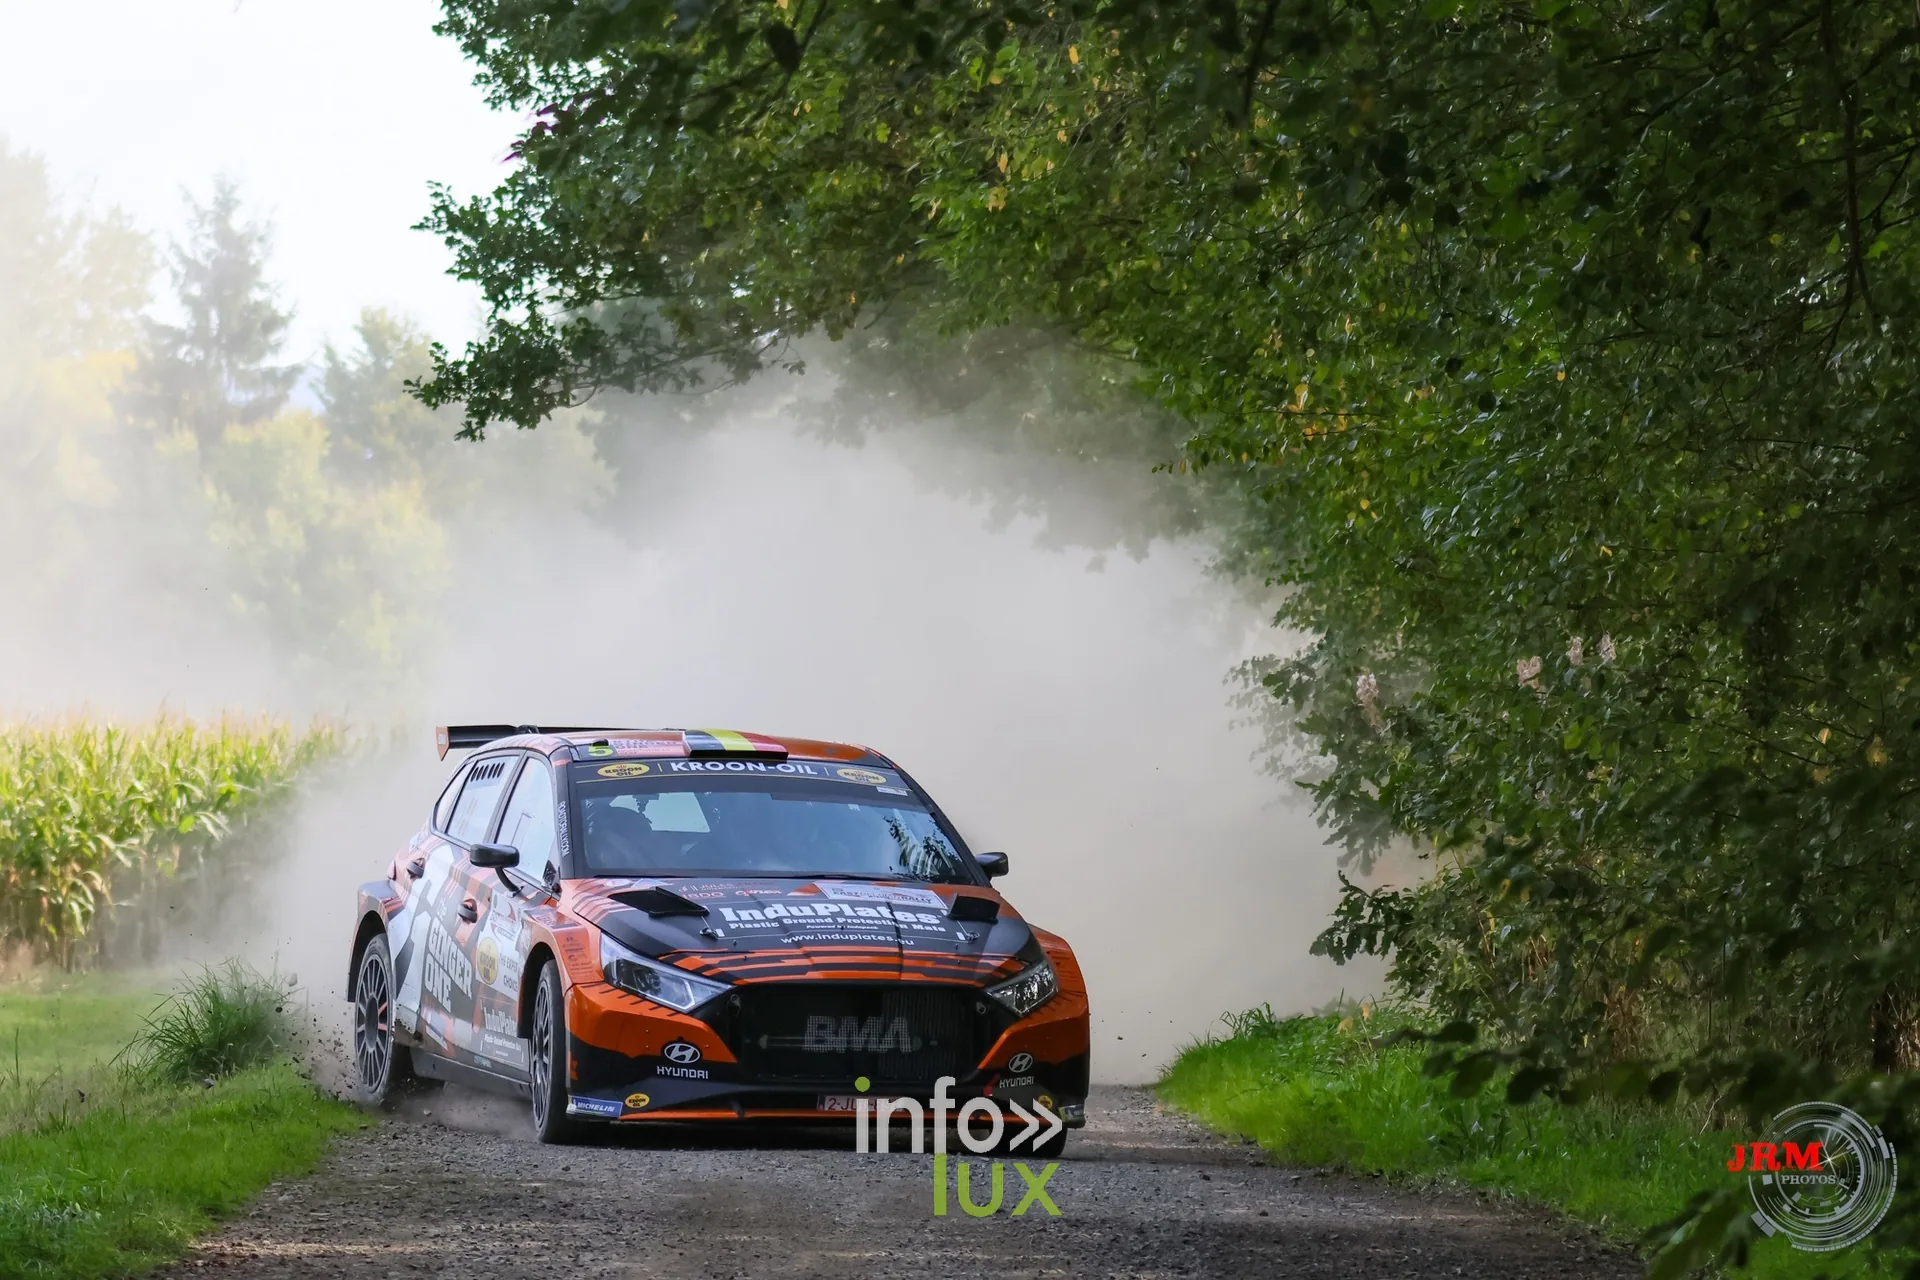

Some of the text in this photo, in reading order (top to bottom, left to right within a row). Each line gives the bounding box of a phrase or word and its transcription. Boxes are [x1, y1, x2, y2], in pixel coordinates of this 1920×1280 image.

[588, 745, 613, 757] 5
[670, 761, 818, 775] KROON-OIL
[729, 917, 946, 932] Plastic Ground Protection Mats
[428, 918, 473, 1000] GINGER
[424, 953, 452, 1013] ONE
[803, 1015, 912, 1053] BMA
[657, 1066, 709, 1079] HYUNDAI
[1000, 1076, 1035, 1089] HYUNDAI
[577, 1102, 616, 1113] MICHELIN
